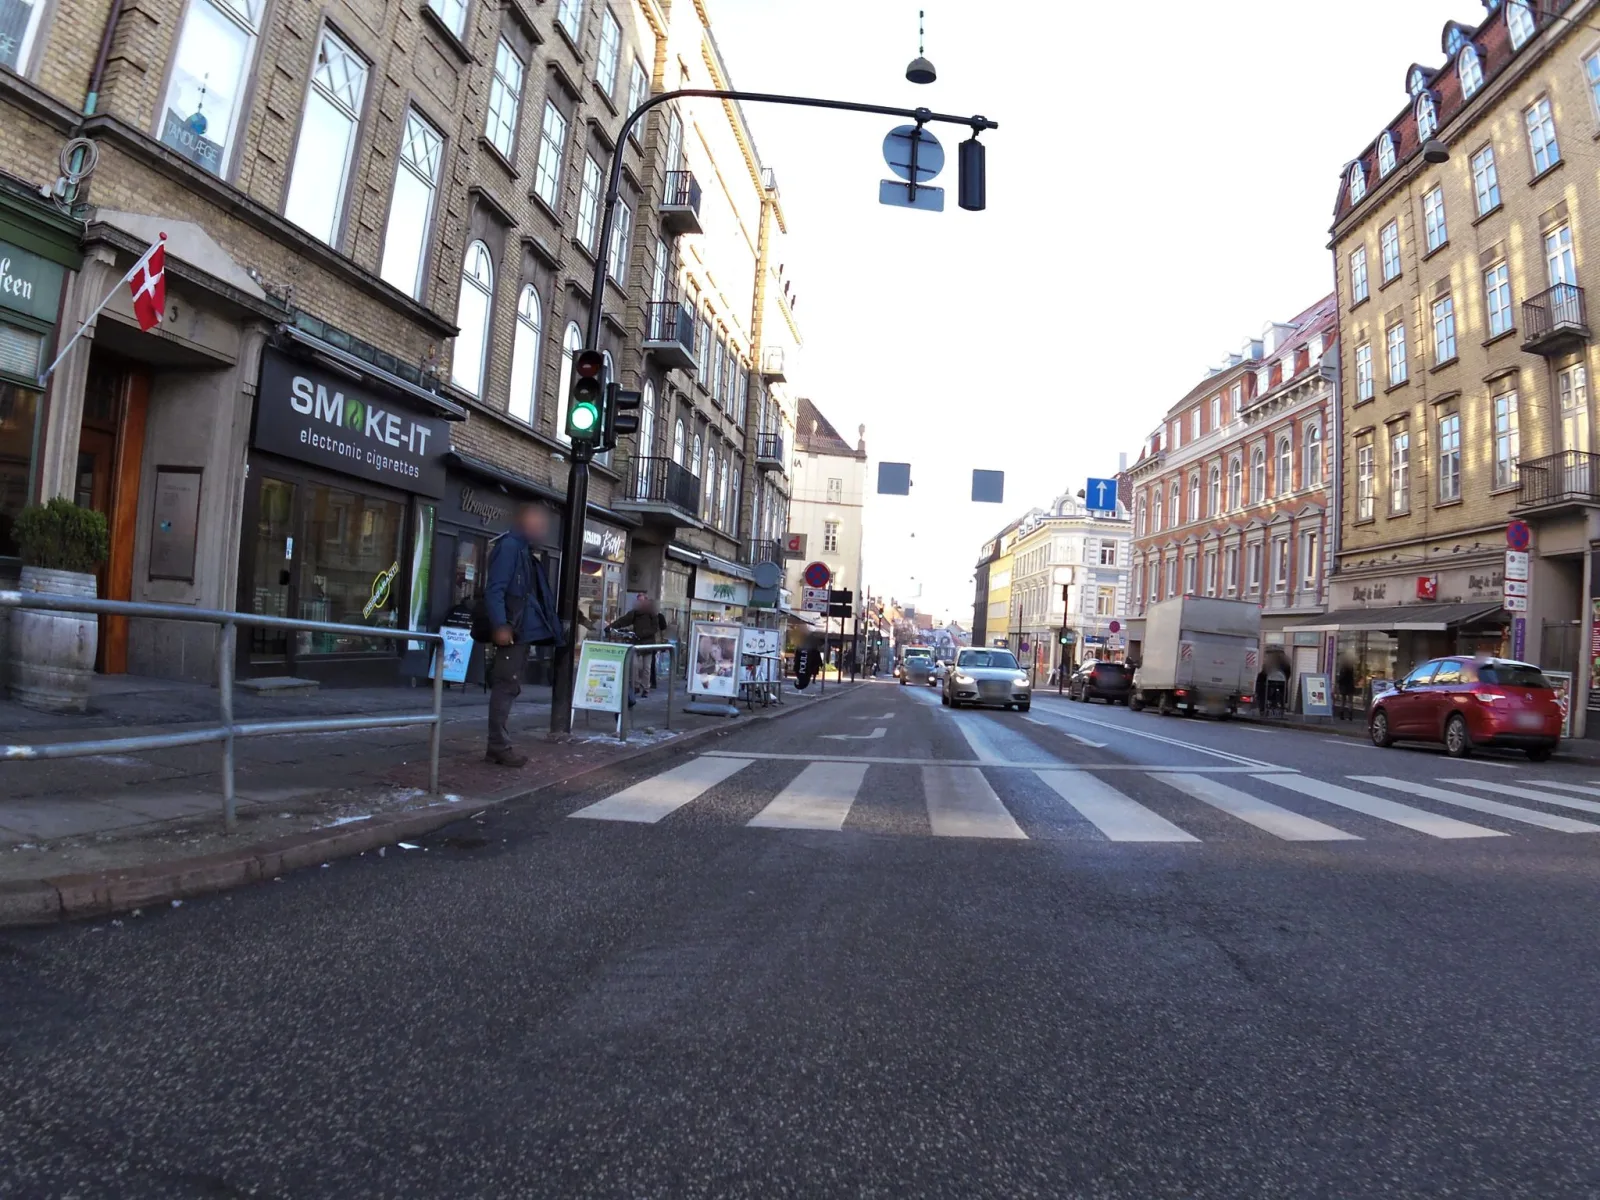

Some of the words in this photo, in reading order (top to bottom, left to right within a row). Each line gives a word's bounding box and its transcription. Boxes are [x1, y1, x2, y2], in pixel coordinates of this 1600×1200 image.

[167, 120, 218, 164] TANDLÆGE
[169, 305, 179, 323] 3
[300, 427, 362, 460] electronic
[366, 449, 420, 478] cigarettes
